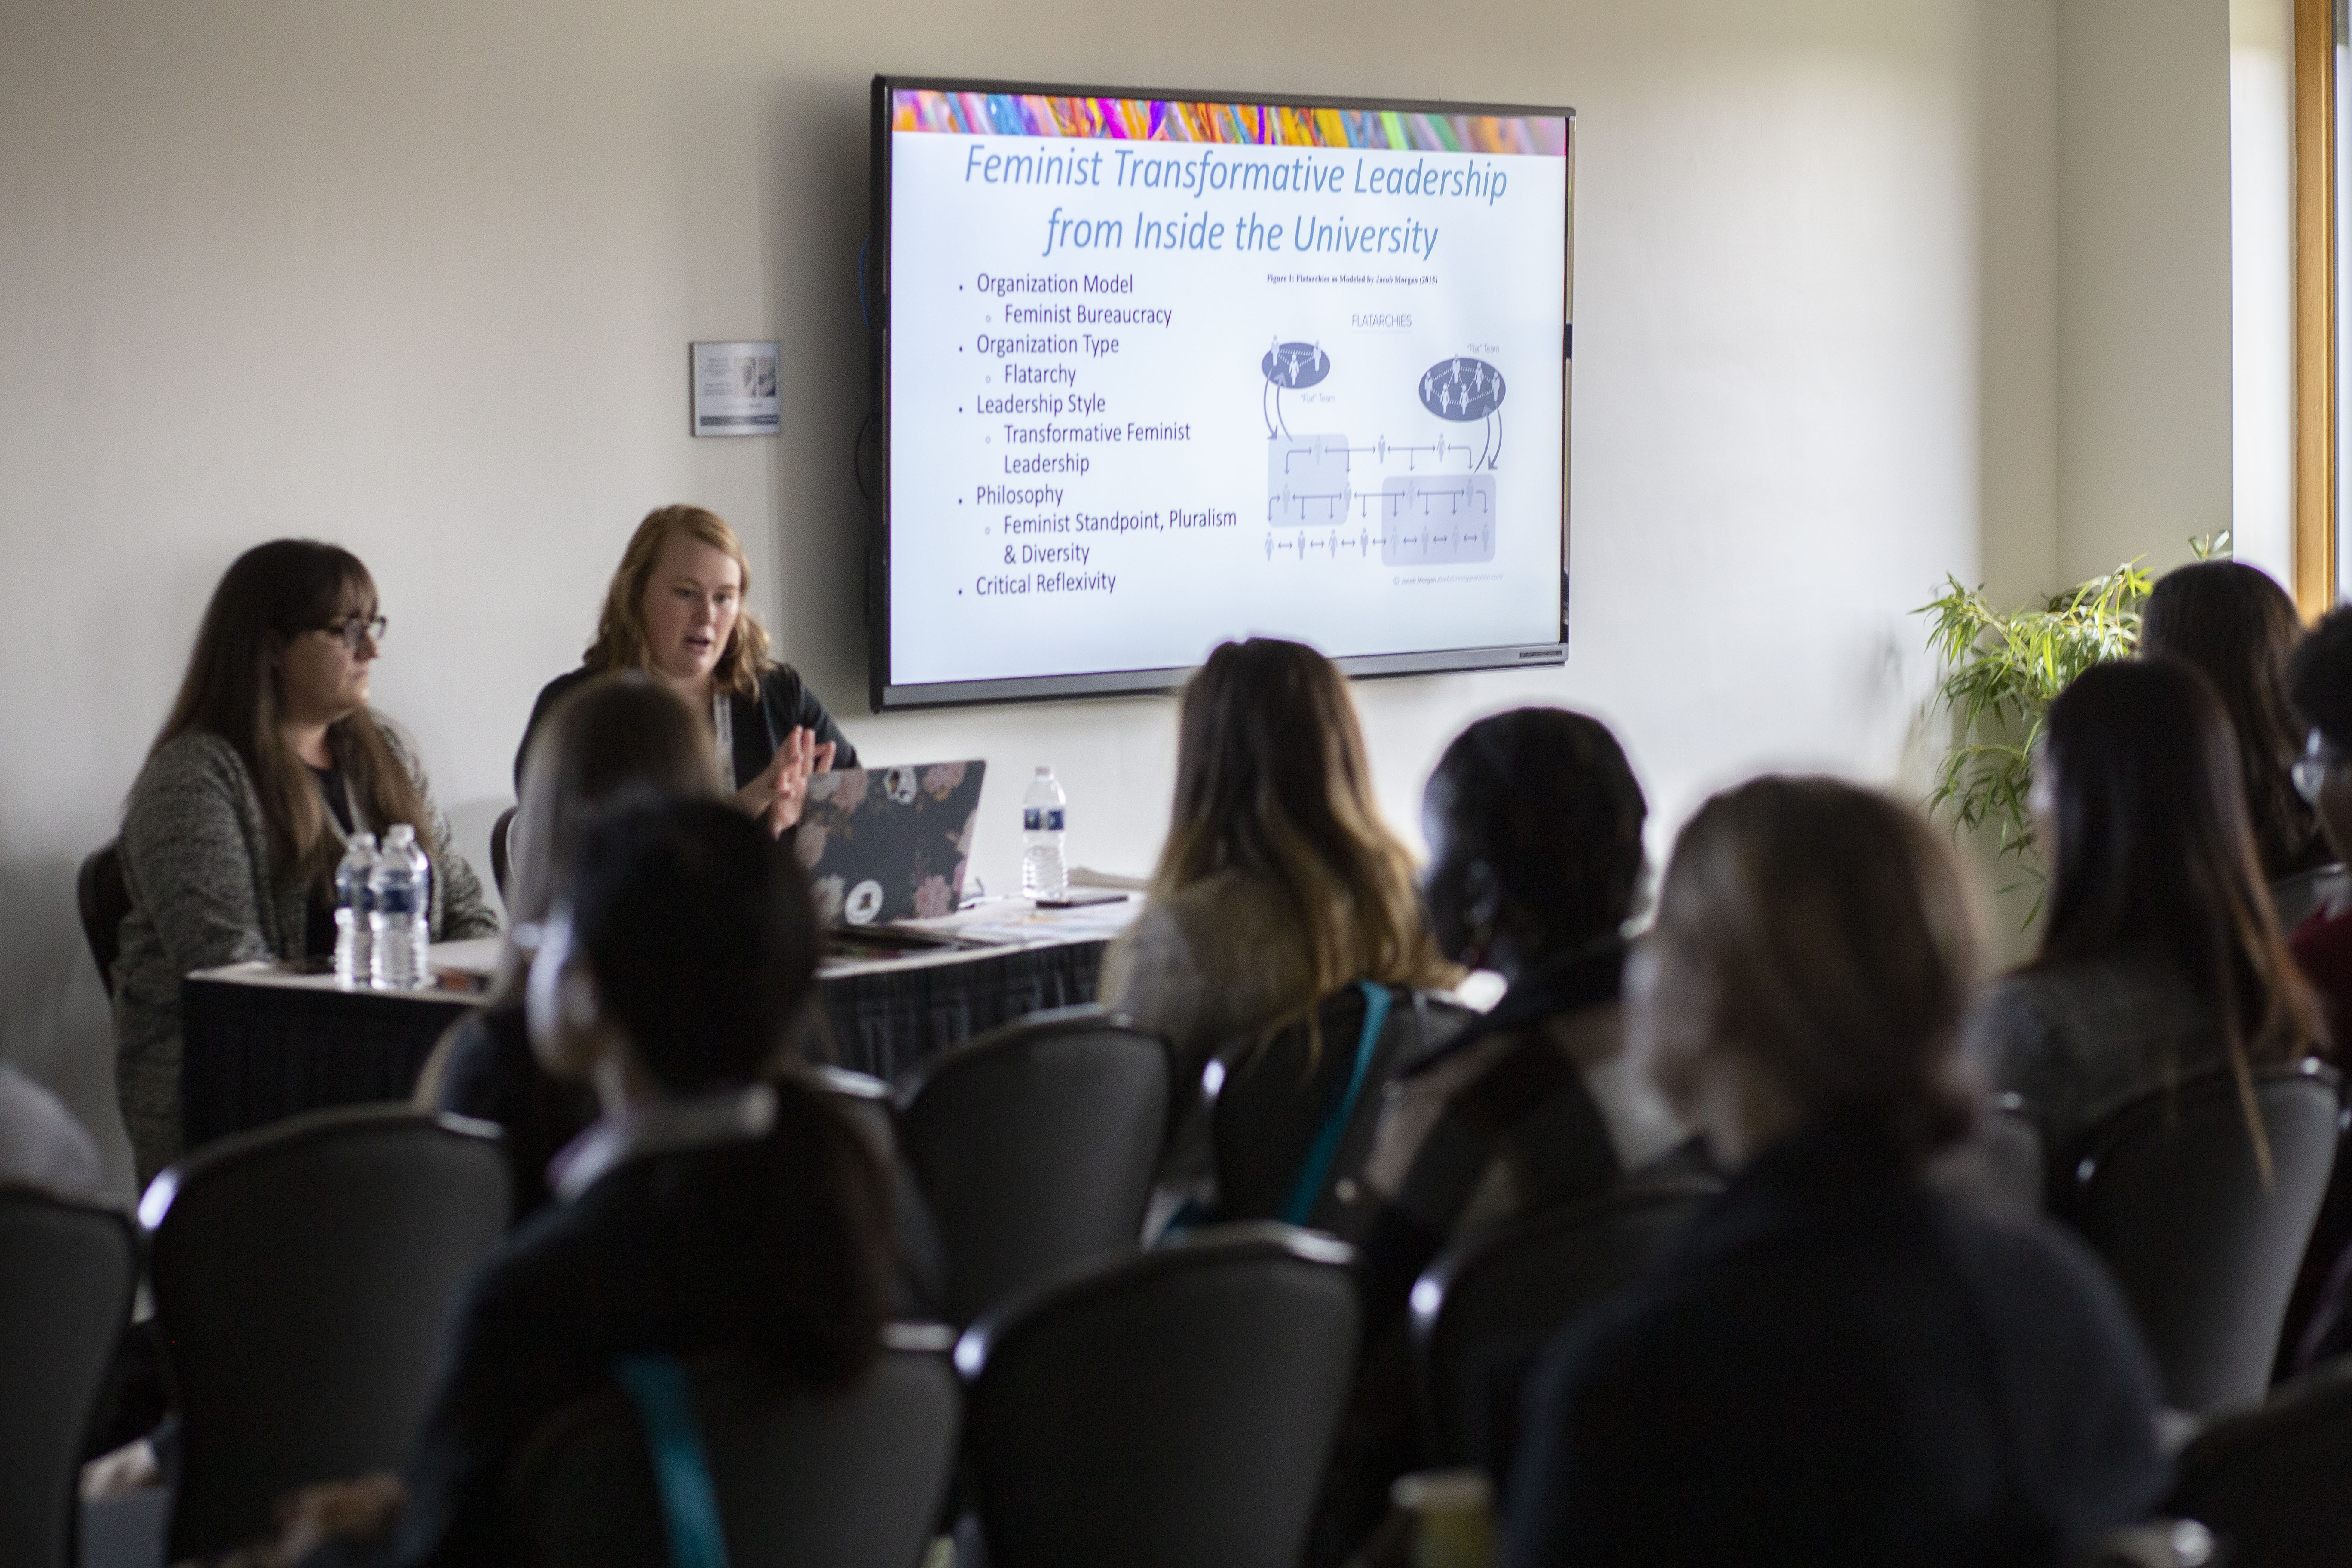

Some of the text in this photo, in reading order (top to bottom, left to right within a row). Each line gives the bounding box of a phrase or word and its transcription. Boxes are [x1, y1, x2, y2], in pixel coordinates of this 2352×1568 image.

[965, 144, 1507, 206] Feminist Transformative Leadership
[1042, 207, 1439, 261] from Inside the University
[977, 273, 1133, 297] Organization Model
[1267, 274, 1287, 284] Figure
[1296, 274, 1330, 283] Flatarchies
[1339, 275, 1365, 284] Modeled
[1367, 275, 1374, 286] by
[1376, 276, 1393, 284] Jacob
[1395, 276, 1418, 286] Morgan
[1005, 304, 1172, 328] Feminist Bureaucracy
[1352, 314, 1412, 328] FLATARCHIES
[977, 334, 1119, 358] Organization Type
[1005, 363, 1076, 387] Flatarchy
[977, 393, 1106, 417] Leadership Style
[1004, 422, 1190, 444] Transformative Feminist
[1004, 453, 1090, 476] Leadership
[977, 484, 1063, 508] Philosophy
[1004, 508, 1237, 534] Feminist Standpoint, Pluralism
[1004, 545, 1090, 565] & Diversity
[976, 572, 1116, 596] Critical Reflexivity
